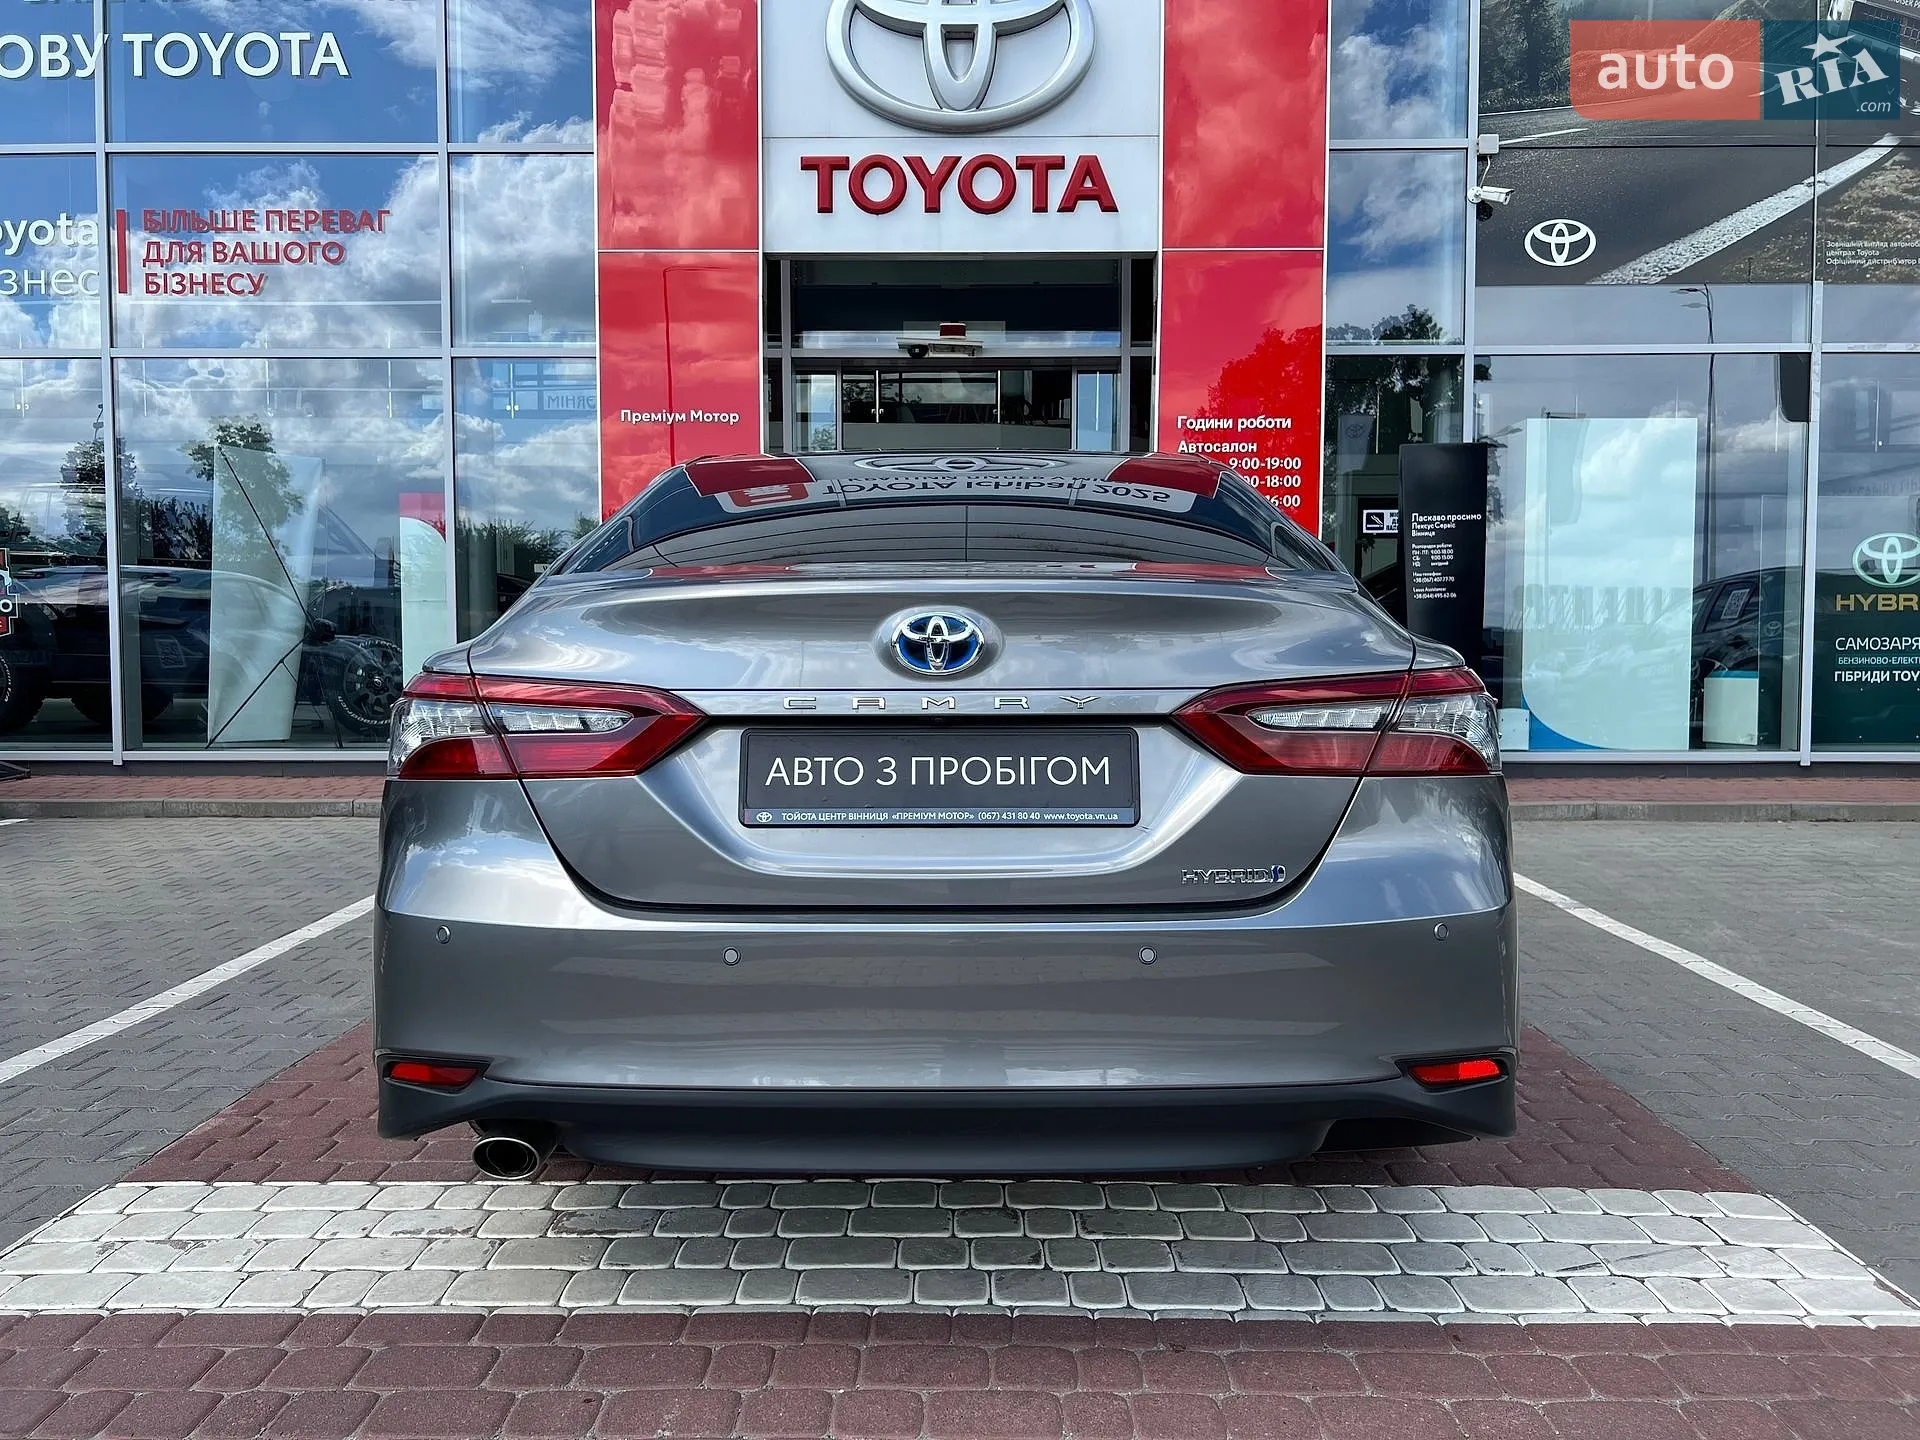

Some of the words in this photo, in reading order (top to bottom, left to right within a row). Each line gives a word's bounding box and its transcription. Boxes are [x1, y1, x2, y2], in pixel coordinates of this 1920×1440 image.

[122, 32, 349, 77] TOYOTA
[800, 154, 1118, 214] TOYOTA
[143, 209, 256, 231] БІЛЬШЕ
[265, 209, 391, 231] ПЕРЕВАГ
[0, 212, 99, 255] yota
[142, 241, 203, 267] ДЛЯ
[212, 241, 345, 264] ВАШОГО
[1857, 249, 1879, 257] Toyota
[144, 272, 266, 295] БІЗНЕСУ
[620, 409, 686, 425] Преміум
[690, 409, 740, 424] Мотор
[1177, 415, 1233, 430] Години
[1237, 415, 1292, 432] роботи
[1178, 441, 1257, 453] Автосалон
[1447, 513, 1482, 522] просимо
[1838, 656, 1920, 664] БЕНЗИНОВО-ЕЛЕКТ
[1834, 671, 1890, 683] ГІБРИДИ
[783, 696, 1099, 710] CAMRY
[765, 757, 864, 786] АВТО
[876, 757, 897, 786] З
[911, 757, 1110, 785] ПРОБІГОМ
[782, 811, 817, 821] ТОЙОТА
[818, 813, 847, 822] ЦЕНТР
[849, 812, 889, 822] ВІННИЦЯ
[892, 811, 936, 820] «ПРЕМІУМ
[938, 811, 975, 820] МОТОР»
[978, 811, 1000, 820] (067)
[1002, 812, 1016, 820] 431
[1018, 812, 1028, 820] 80
[1030, 812, 1041, 820] 40
[1044, 812, 1119, 821] www.toyota.vn.ua
[1181, 869, 1270, 884] HYBRID
